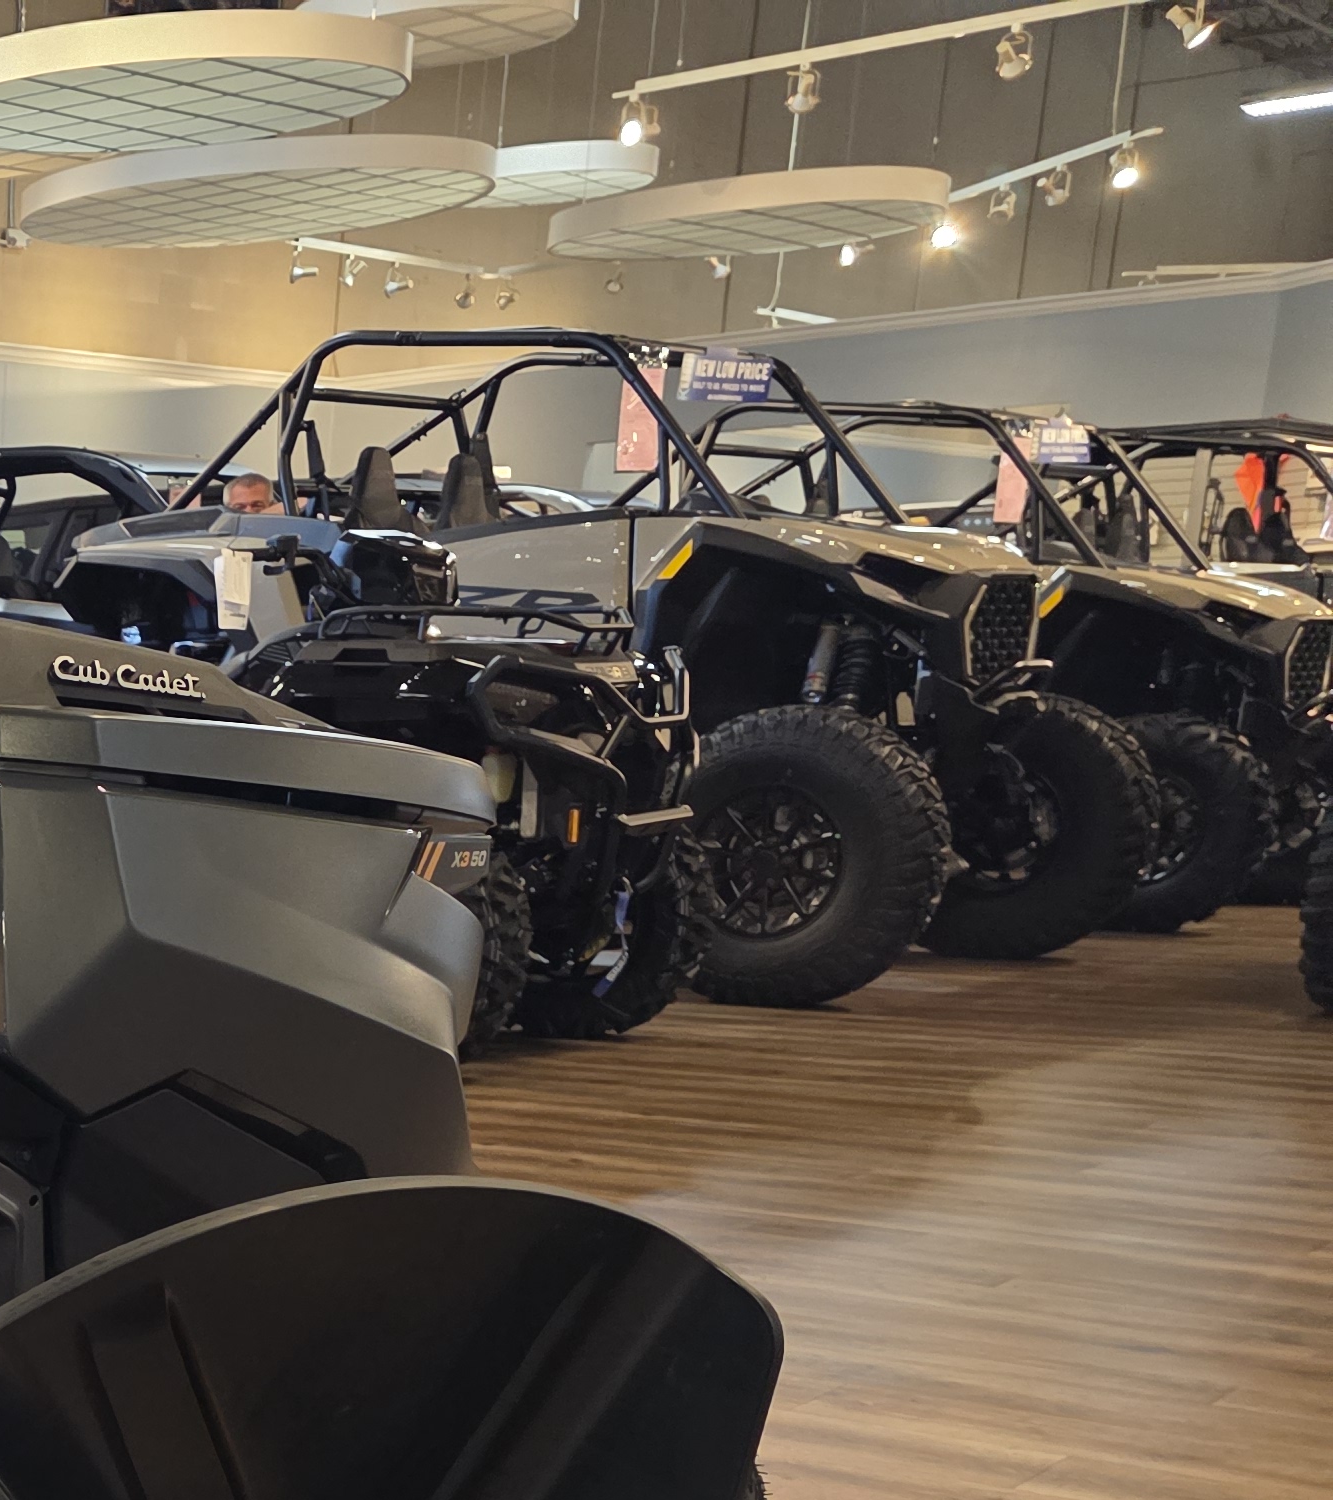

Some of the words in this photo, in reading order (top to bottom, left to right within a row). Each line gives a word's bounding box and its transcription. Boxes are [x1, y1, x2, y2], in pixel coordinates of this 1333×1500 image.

[737, 362, 771, 380] PRICE
[53, 655, 111, 686] Cub
[116, 664, 204, 699] Cadet
